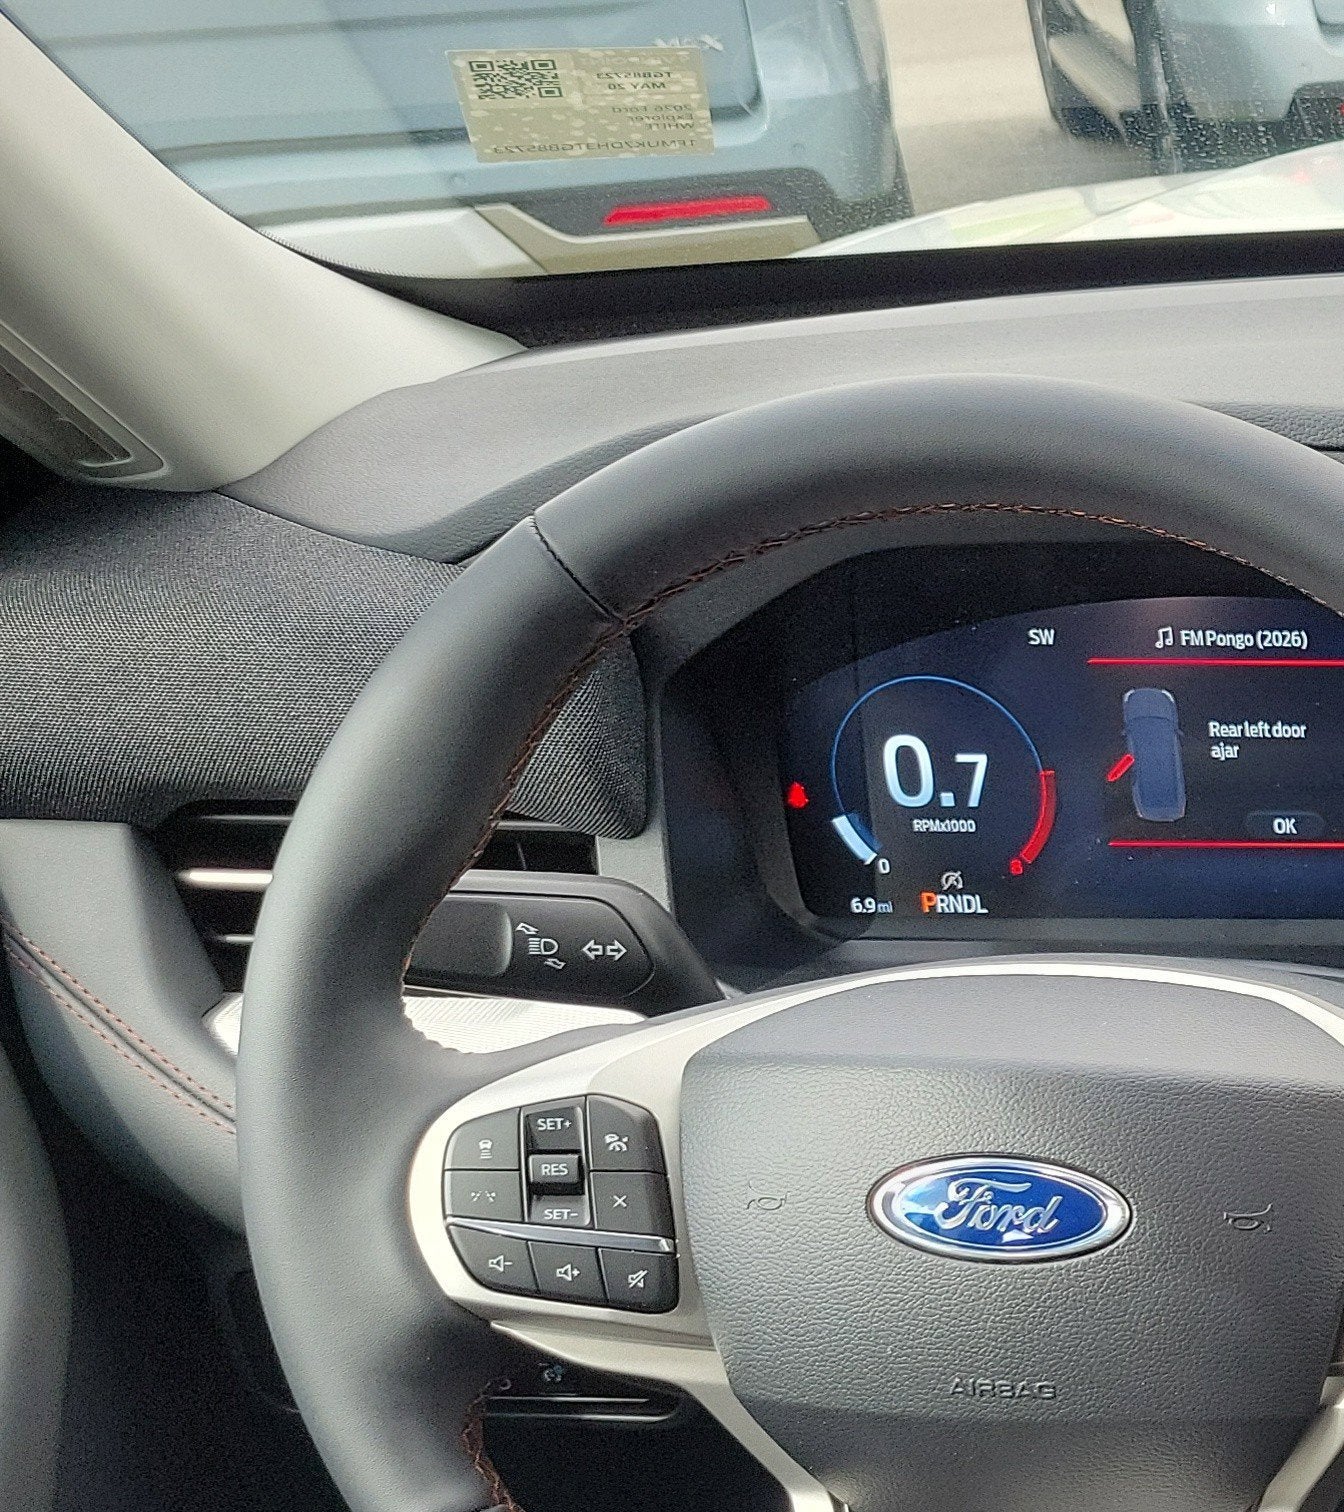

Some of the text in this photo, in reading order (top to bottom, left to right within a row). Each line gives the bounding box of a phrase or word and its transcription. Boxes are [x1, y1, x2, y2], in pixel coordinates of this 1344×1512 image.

[1028, 628, 1055, 645] SW
[1180, 630, 1308, 649] FM Pongo (2026)
[1208, 720, 1307, 739] Rear left door
[1211, 742, 1240, 760] ajar
[882, 733, 988, 808] 0.7
[1273, 818, 1297, 835] OK
[877, 858, 890, 874] 0
[537, 1118, 572, 1132] SET+
[541, 1163, 568, 1175] RES
[931, 1175, 1062, 1235] Ford
[948, 1375, 1057, 1400] AIRBAG
